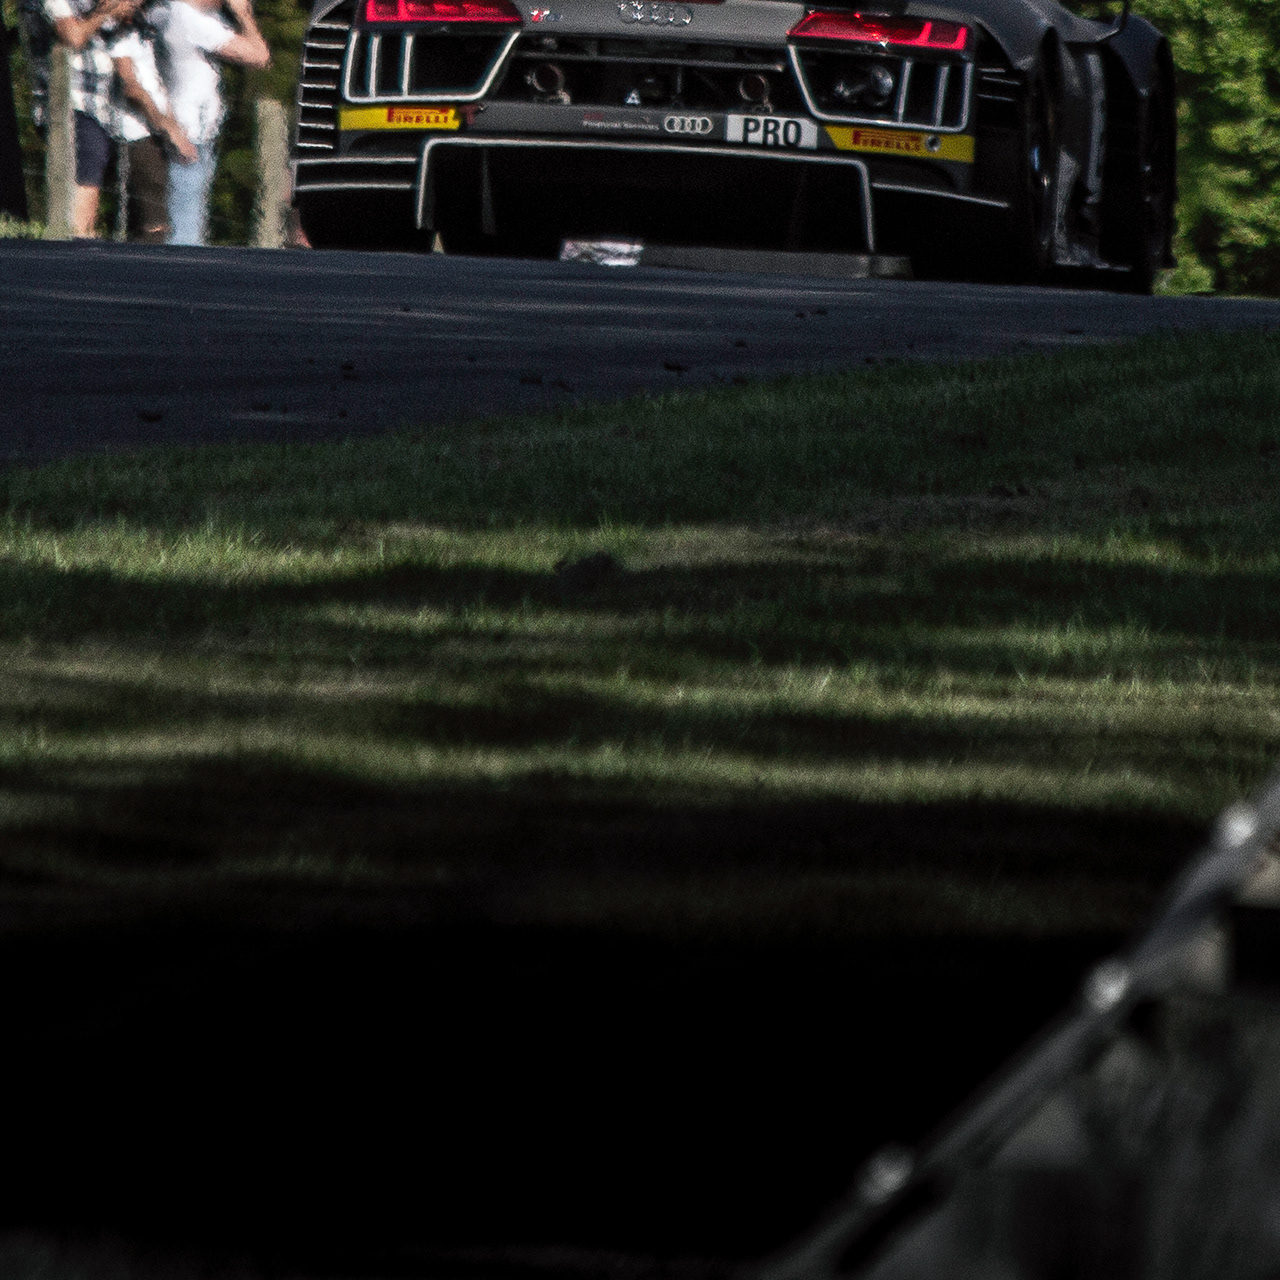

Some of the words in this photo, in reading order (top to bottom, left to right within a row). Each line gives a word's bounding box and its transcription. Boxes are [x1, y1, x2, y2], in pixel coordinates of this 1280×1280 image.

[387, 106, 448, 124] PIRELLI
[742, 116, 803, 147] PRO
[852, 129, 922, 152] PIRELLI
